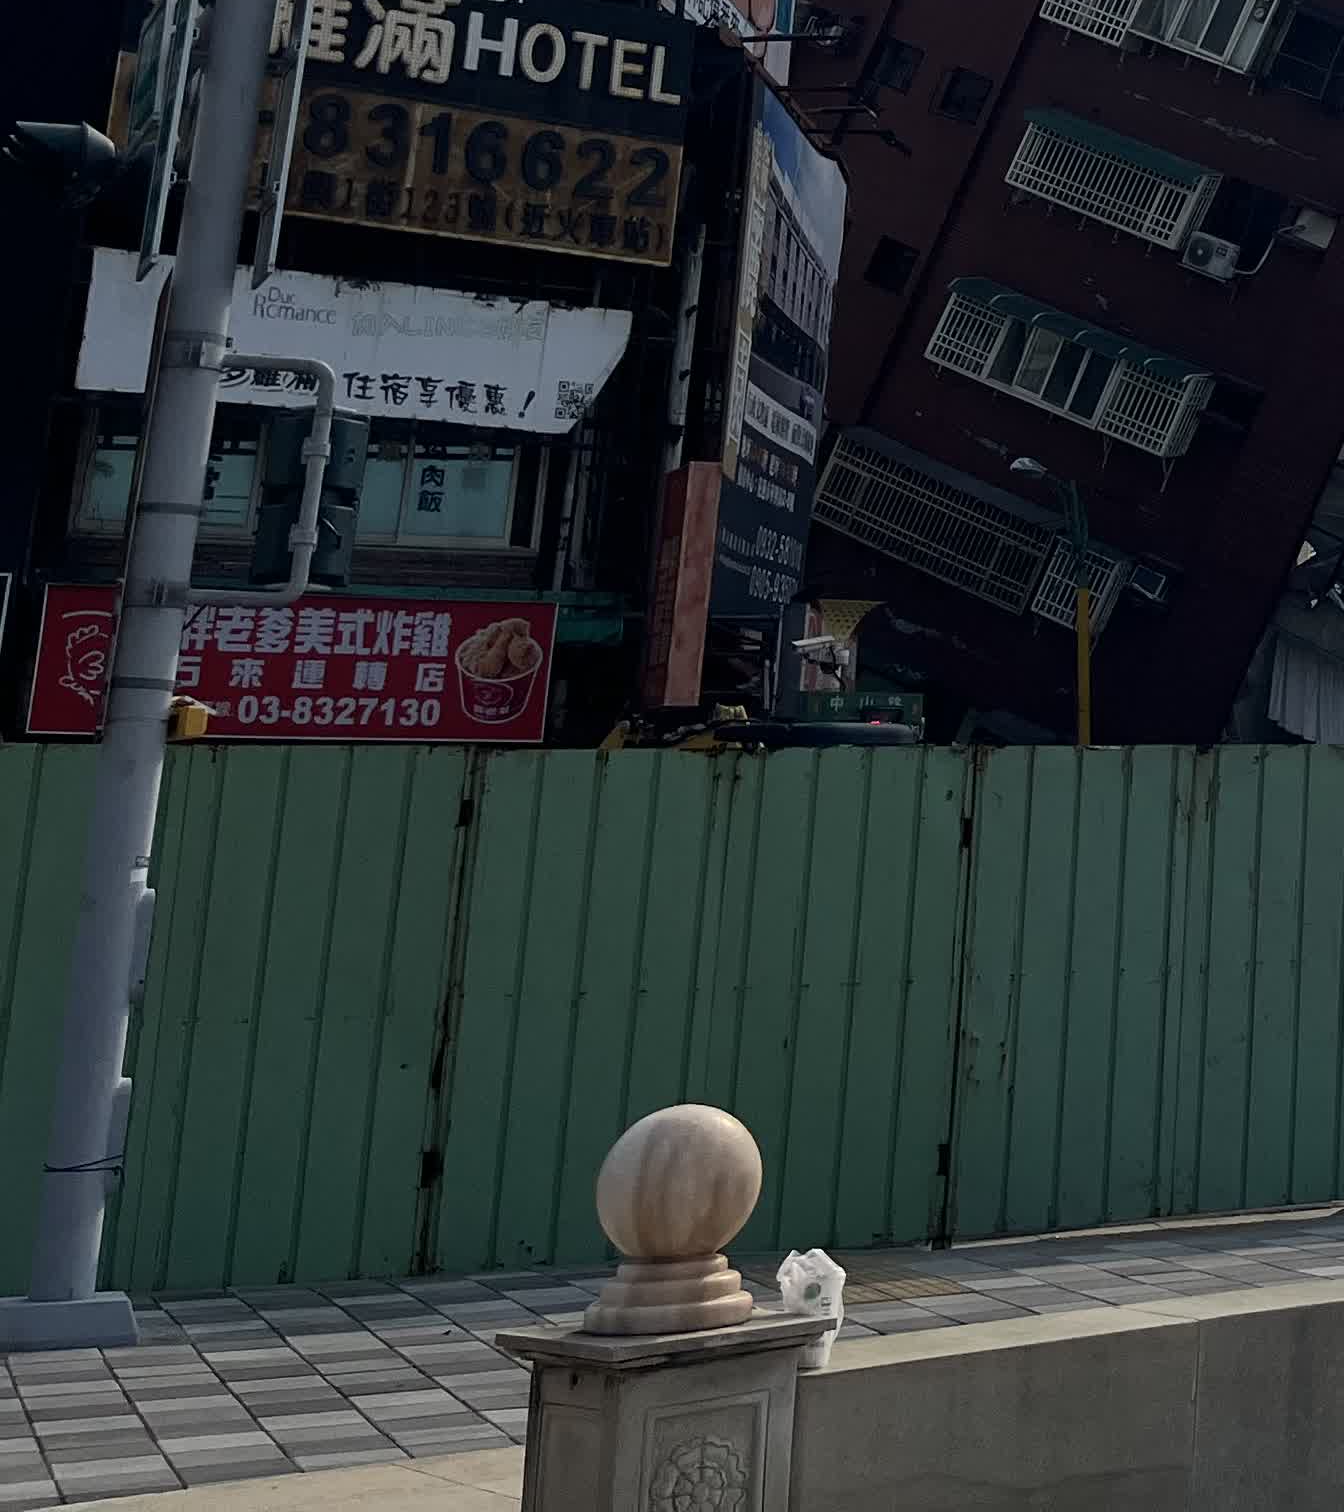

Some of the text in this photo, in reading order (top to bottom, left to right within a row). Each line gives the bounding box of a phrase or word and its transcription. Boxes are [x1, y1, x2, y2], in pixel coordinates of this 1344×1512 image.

[462, 9, 682, 106] HOTEL
[253, 294, 337, 325] Romance
[238, 695, 441, 727] 03-8327130
